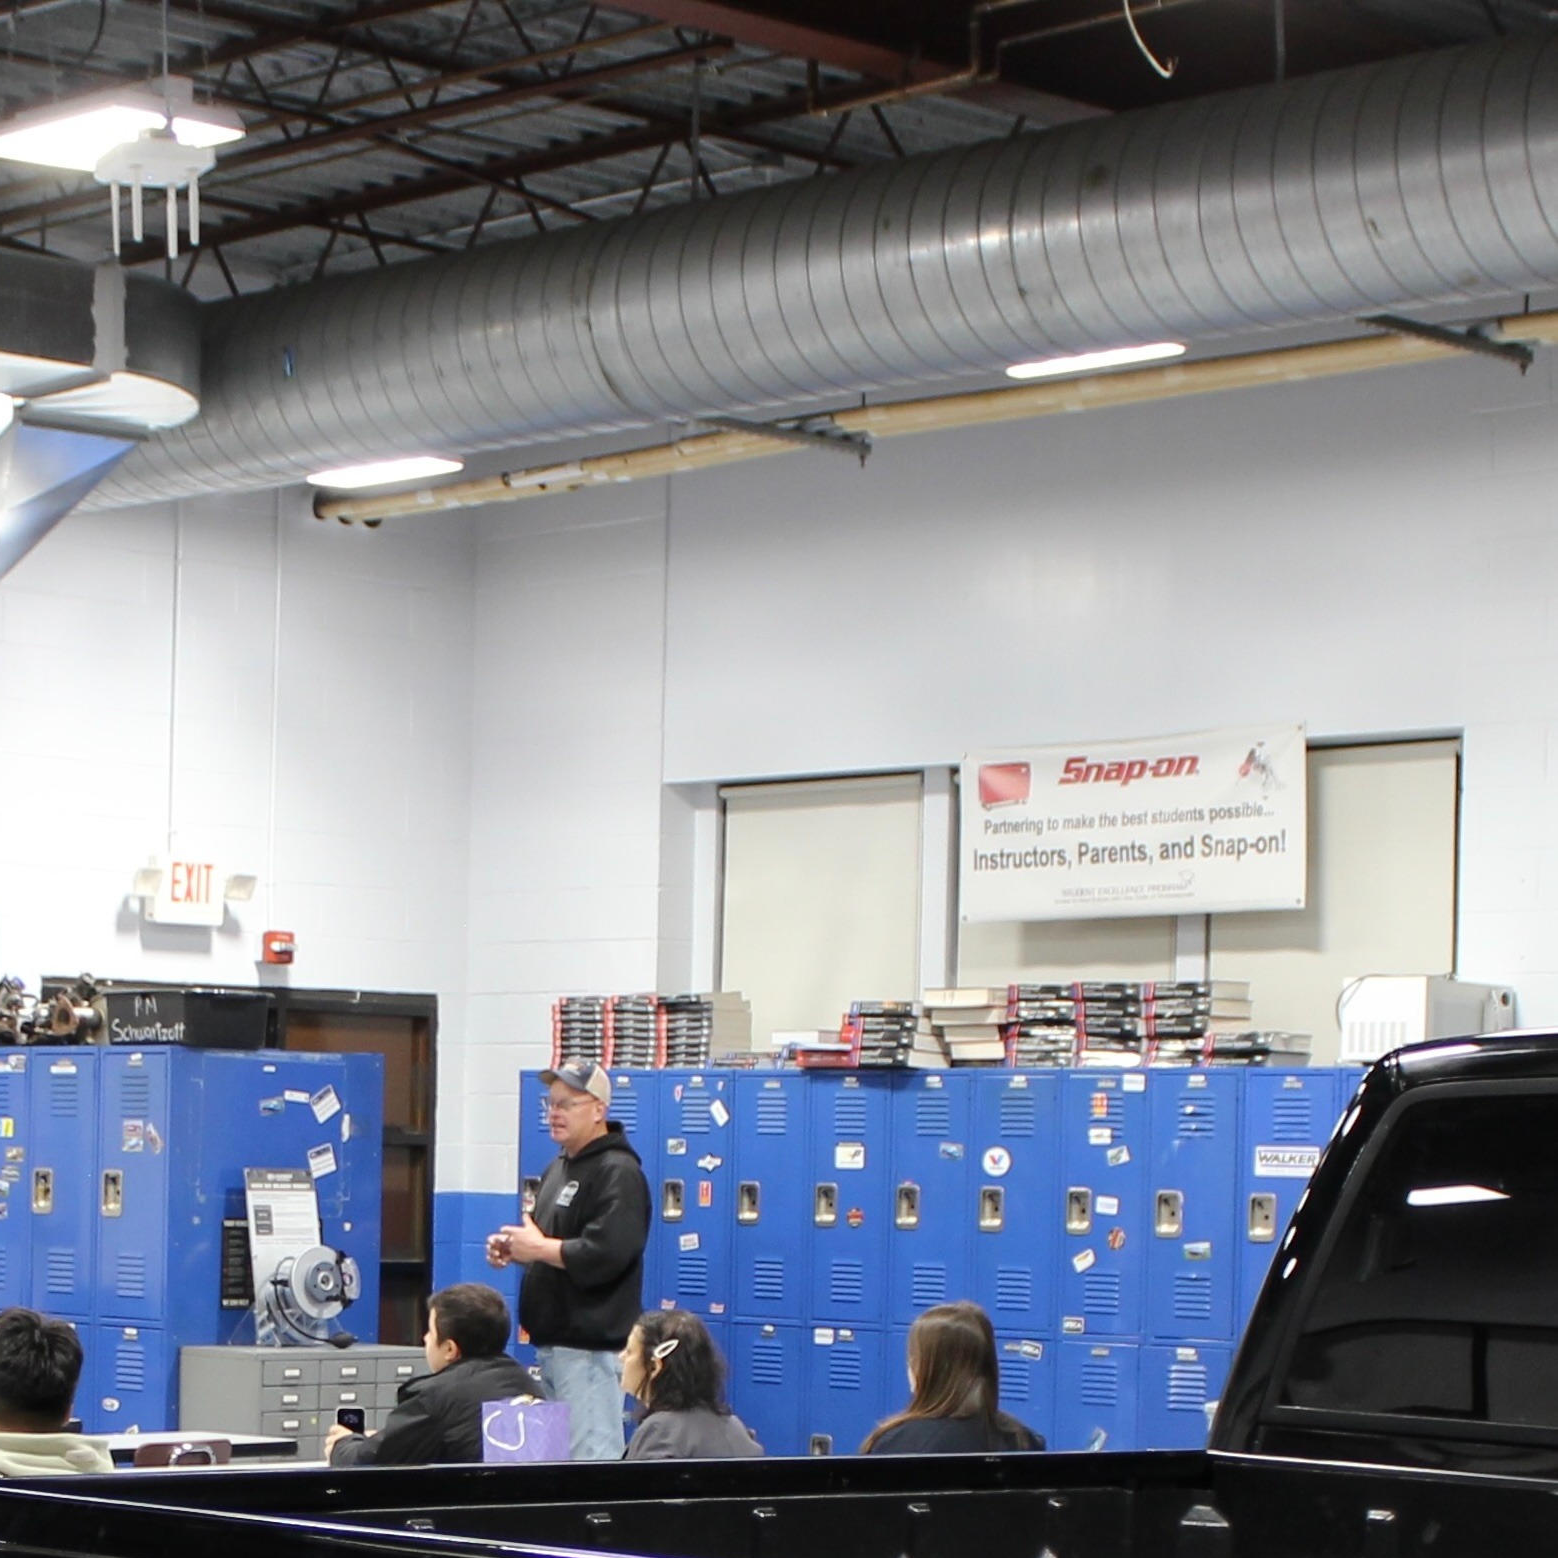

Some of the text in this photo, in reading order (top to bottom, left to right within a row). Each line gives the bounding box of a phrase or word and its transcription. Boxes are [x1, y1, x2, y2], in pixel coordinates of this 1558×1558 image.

[1058, 754, 1199, 785] Snap-on
[983, 801, 1276, 835] Partnering to make the best students possible...
[973, 829, 1286, 871] Instructors, Parents, and Snap-on!
[171, 861, 213, 904] EXIT
[1257, 1150, 1319, 1167] WALKER
